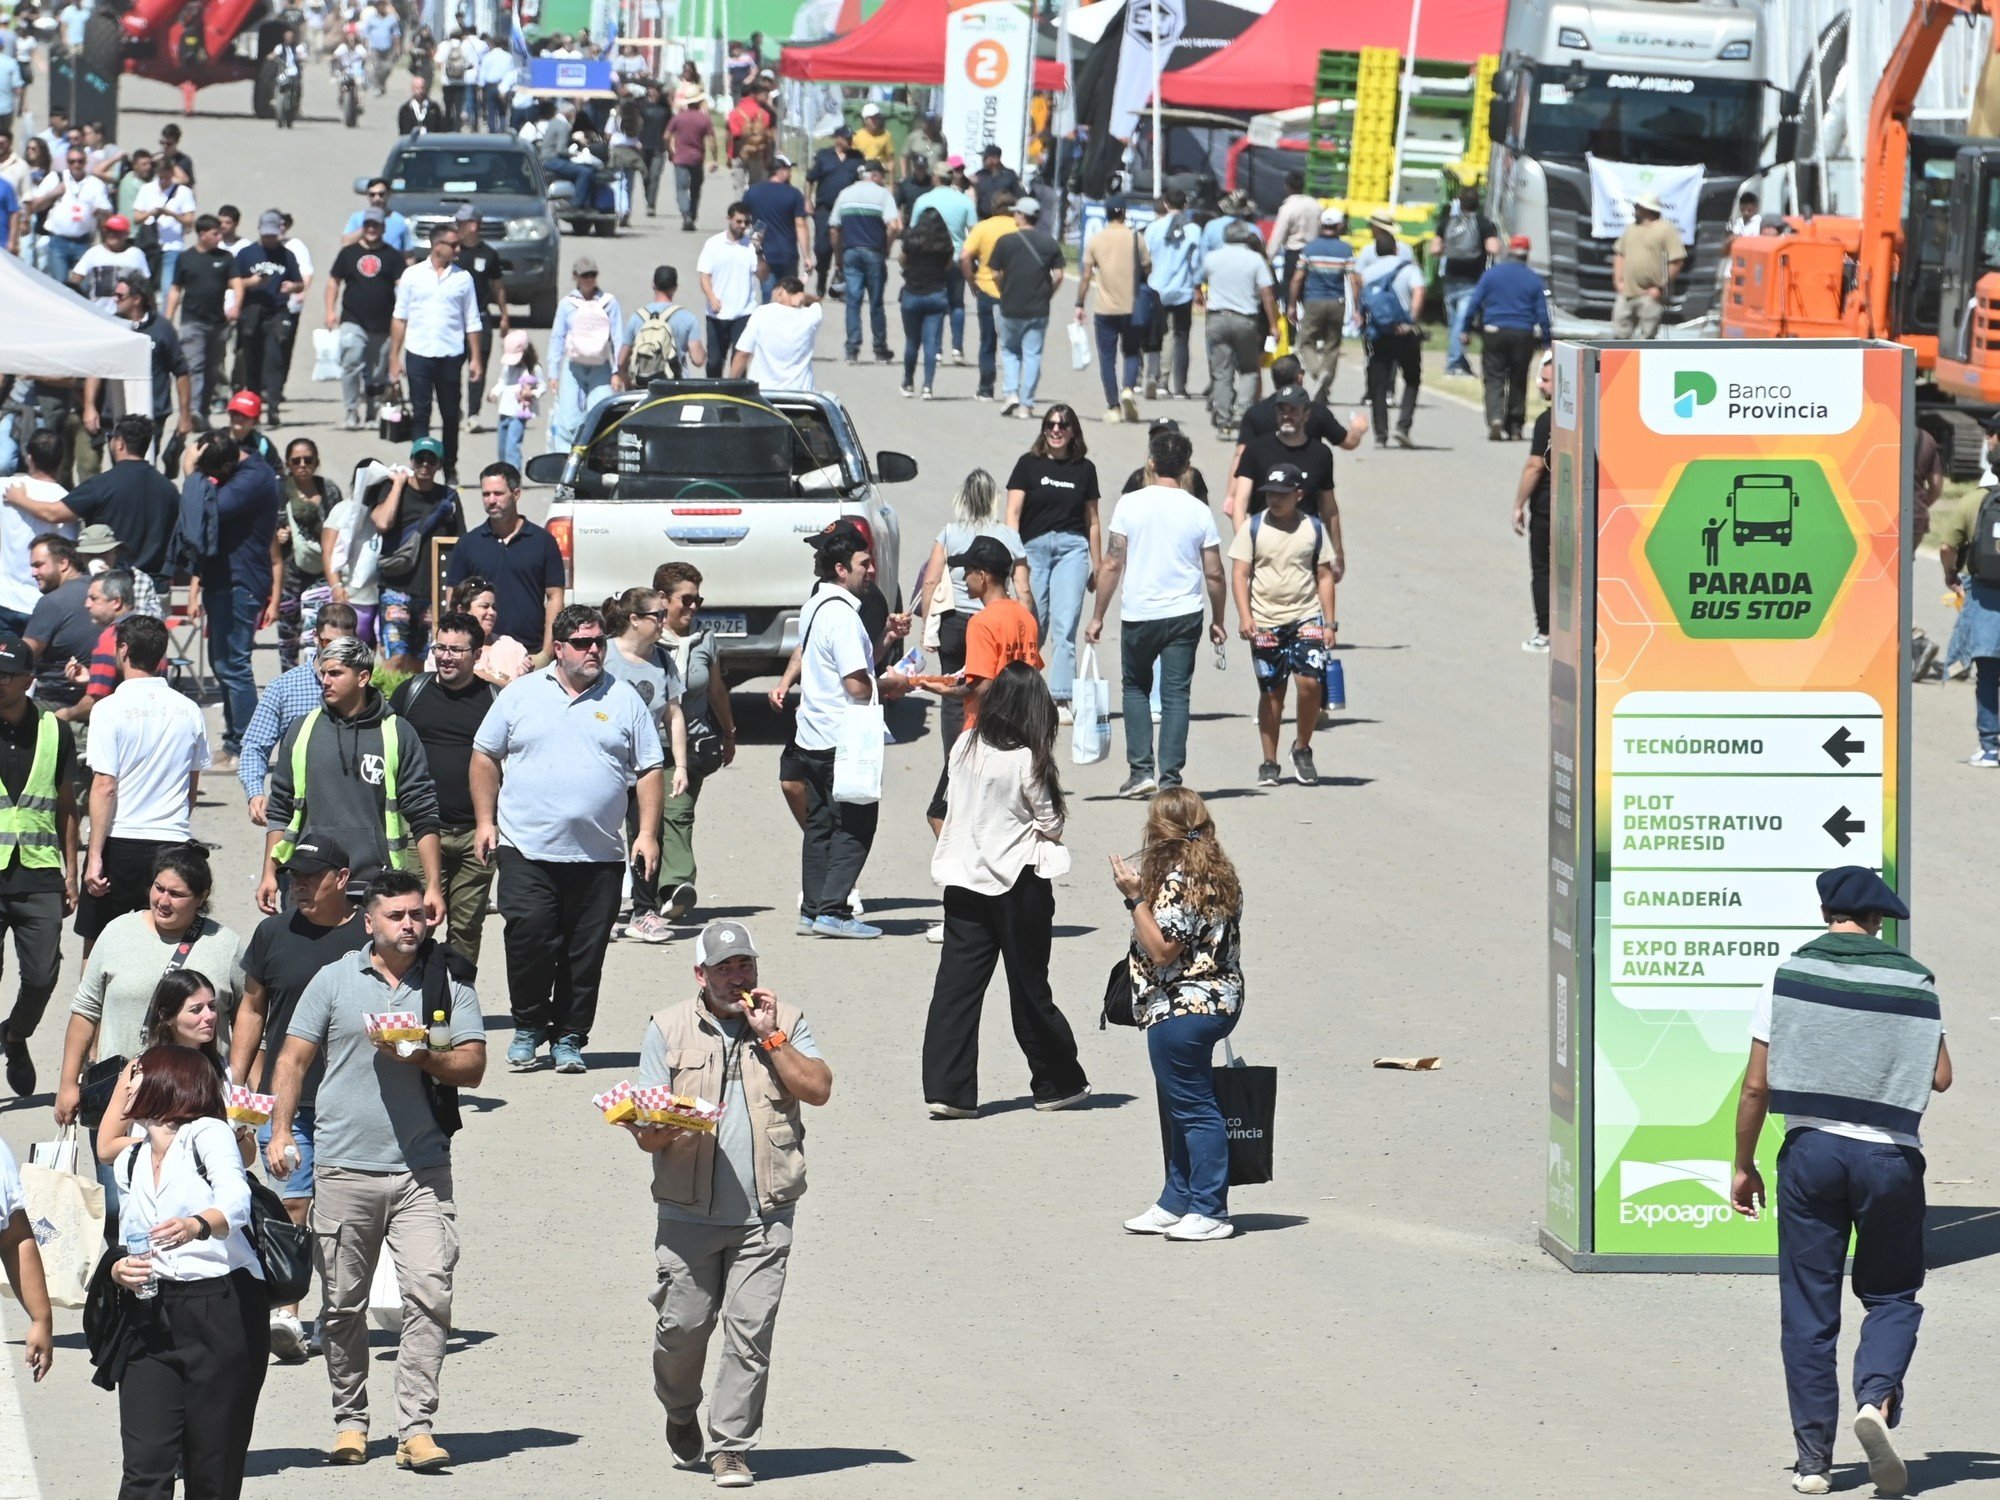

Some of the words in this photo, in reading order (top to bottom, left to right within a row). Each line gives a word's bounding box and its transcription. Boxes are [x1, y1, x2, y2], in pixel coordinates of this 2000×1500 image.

[975, 48, 998, 80] 2
[981, 95, 998, 146] ERTOS
[1728, 382, 1792, 400] Banco
[1728, 402, 1829, 420] Provincia
[792, 524, 824, 533] HILU
[1689, 572, 1813, 595] PARADA
[1690, 601, 1740, 620] BUS
[1746, 601, 1812, 620] STOP
[1623, 734, 1764, 755] TECNÓDROMO
[1623, 795, 1675, 810] PLOT
[1623, 815, 1783, 831] DEMOSTRATIVO
[1623, 835, 1725, 851] AAPRESID
[1623, 886, 1743, 907] GANADERÍA
[1623, 941, 1677, 957] EXPO
[1685, 940, 1780, 957] BRAFORD
[1623, 960, 1705, 977] AVANZA
[1226, 1117, 1242, 1127] co
[1225, 1127, 1264, 1139] vincia
[1619, 1201, 1733, 1229] Expoagro
